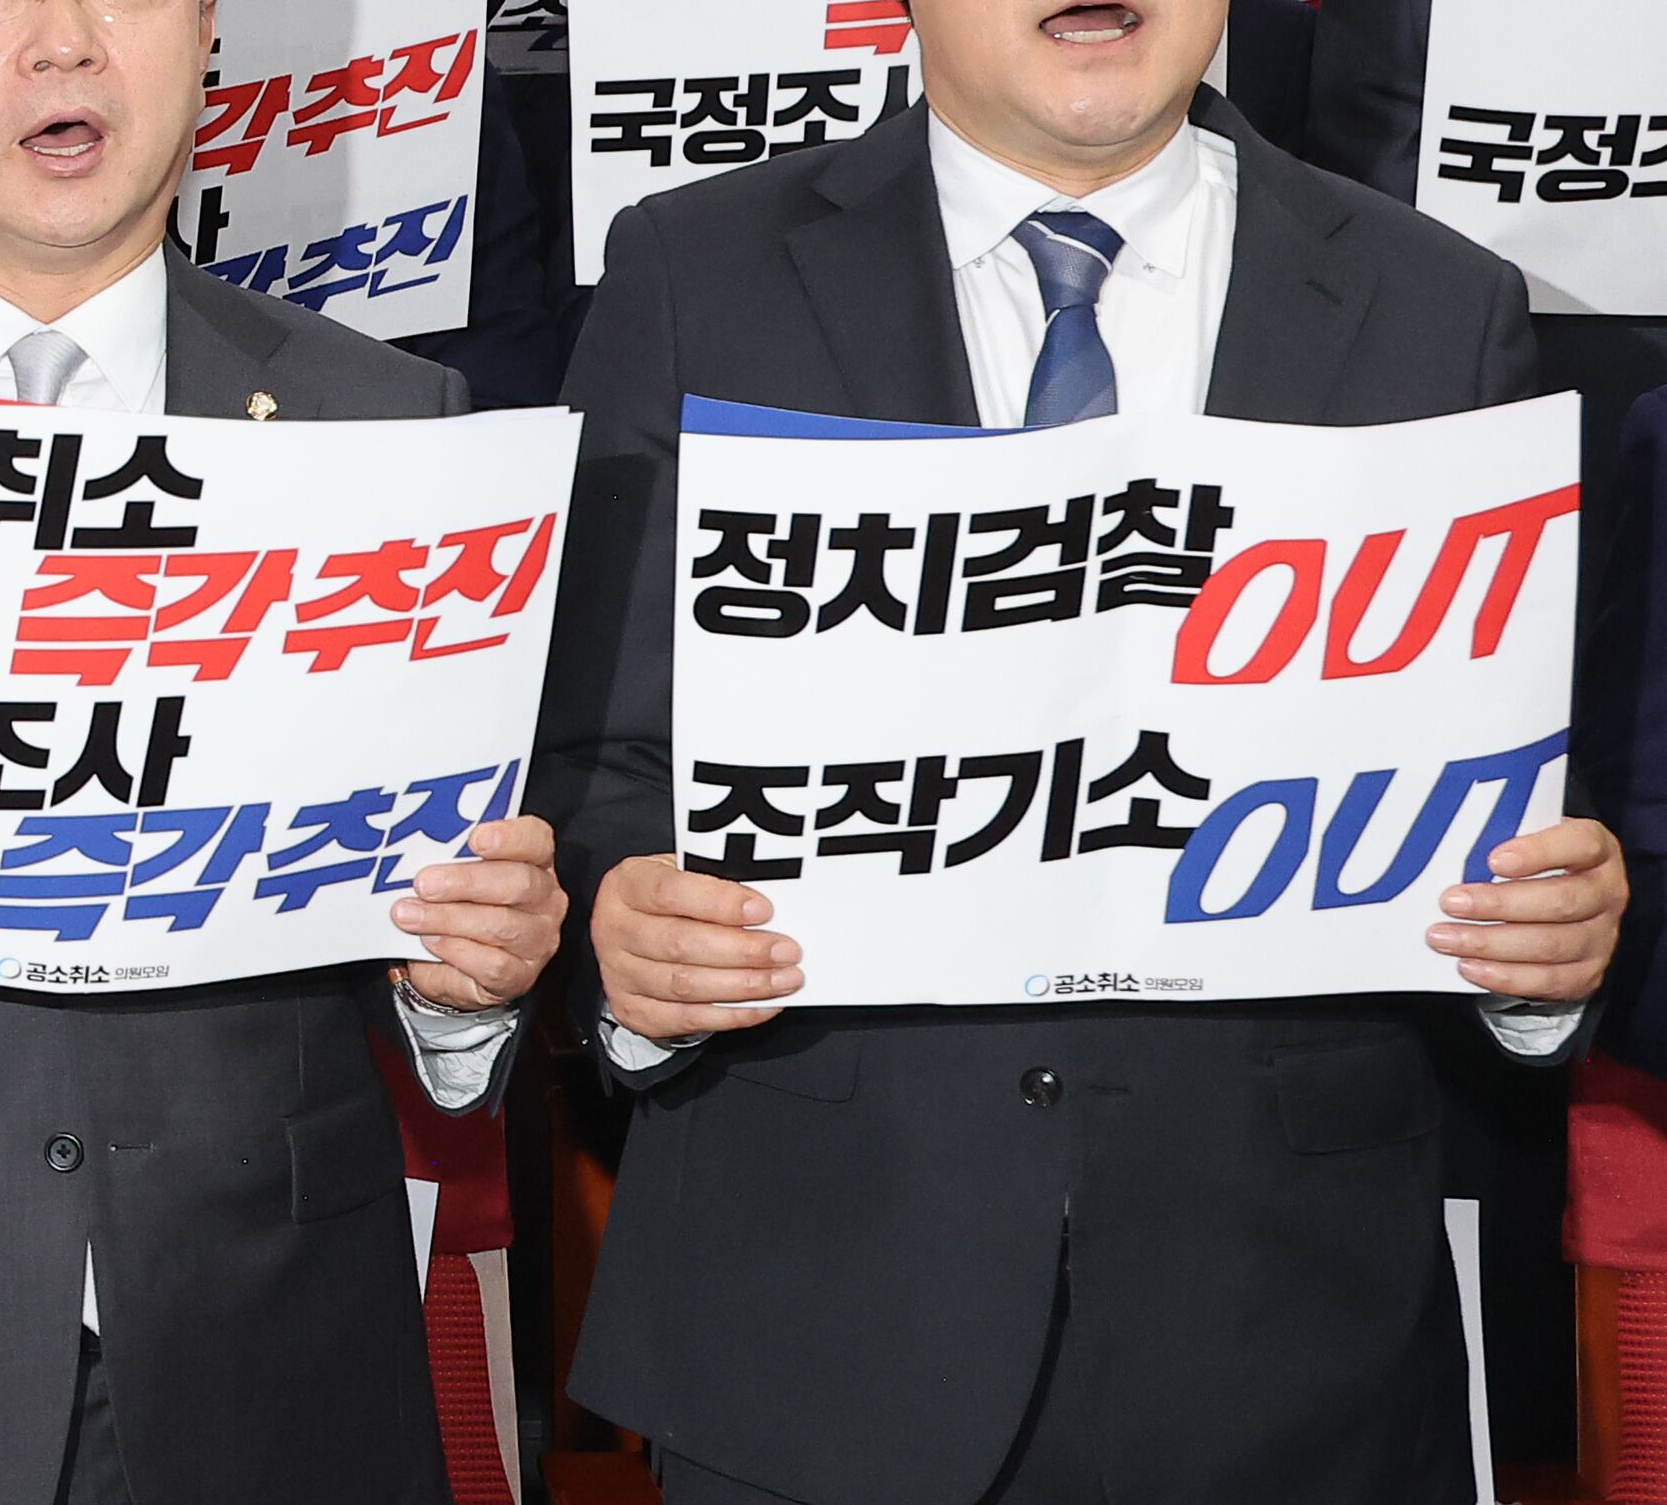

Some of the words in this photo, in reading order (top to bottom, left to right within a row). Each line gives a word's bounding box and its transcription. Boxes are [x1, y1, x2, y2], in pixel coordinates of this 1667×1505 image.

[285, 28, 479, 158] 추진
[8, 548, 299, 687] 즉각
[282, 511, 559, 674] 추진
[690, 478, 1235, 640] 정치검찰
[1169, 481, 1582, 686] OUT
[253, 757, 524, 915] 추진
[682, 728, 1211, 883] 조작기소
[1164, 725, 1572, 925] OUT
[26, 961, 111, 985] 공소취소
[113, 964, 170, 981] 의원모임
[1053, 972, 1140, 994] 공소취소
[1143, 976, 1205, 992] 의원모임
